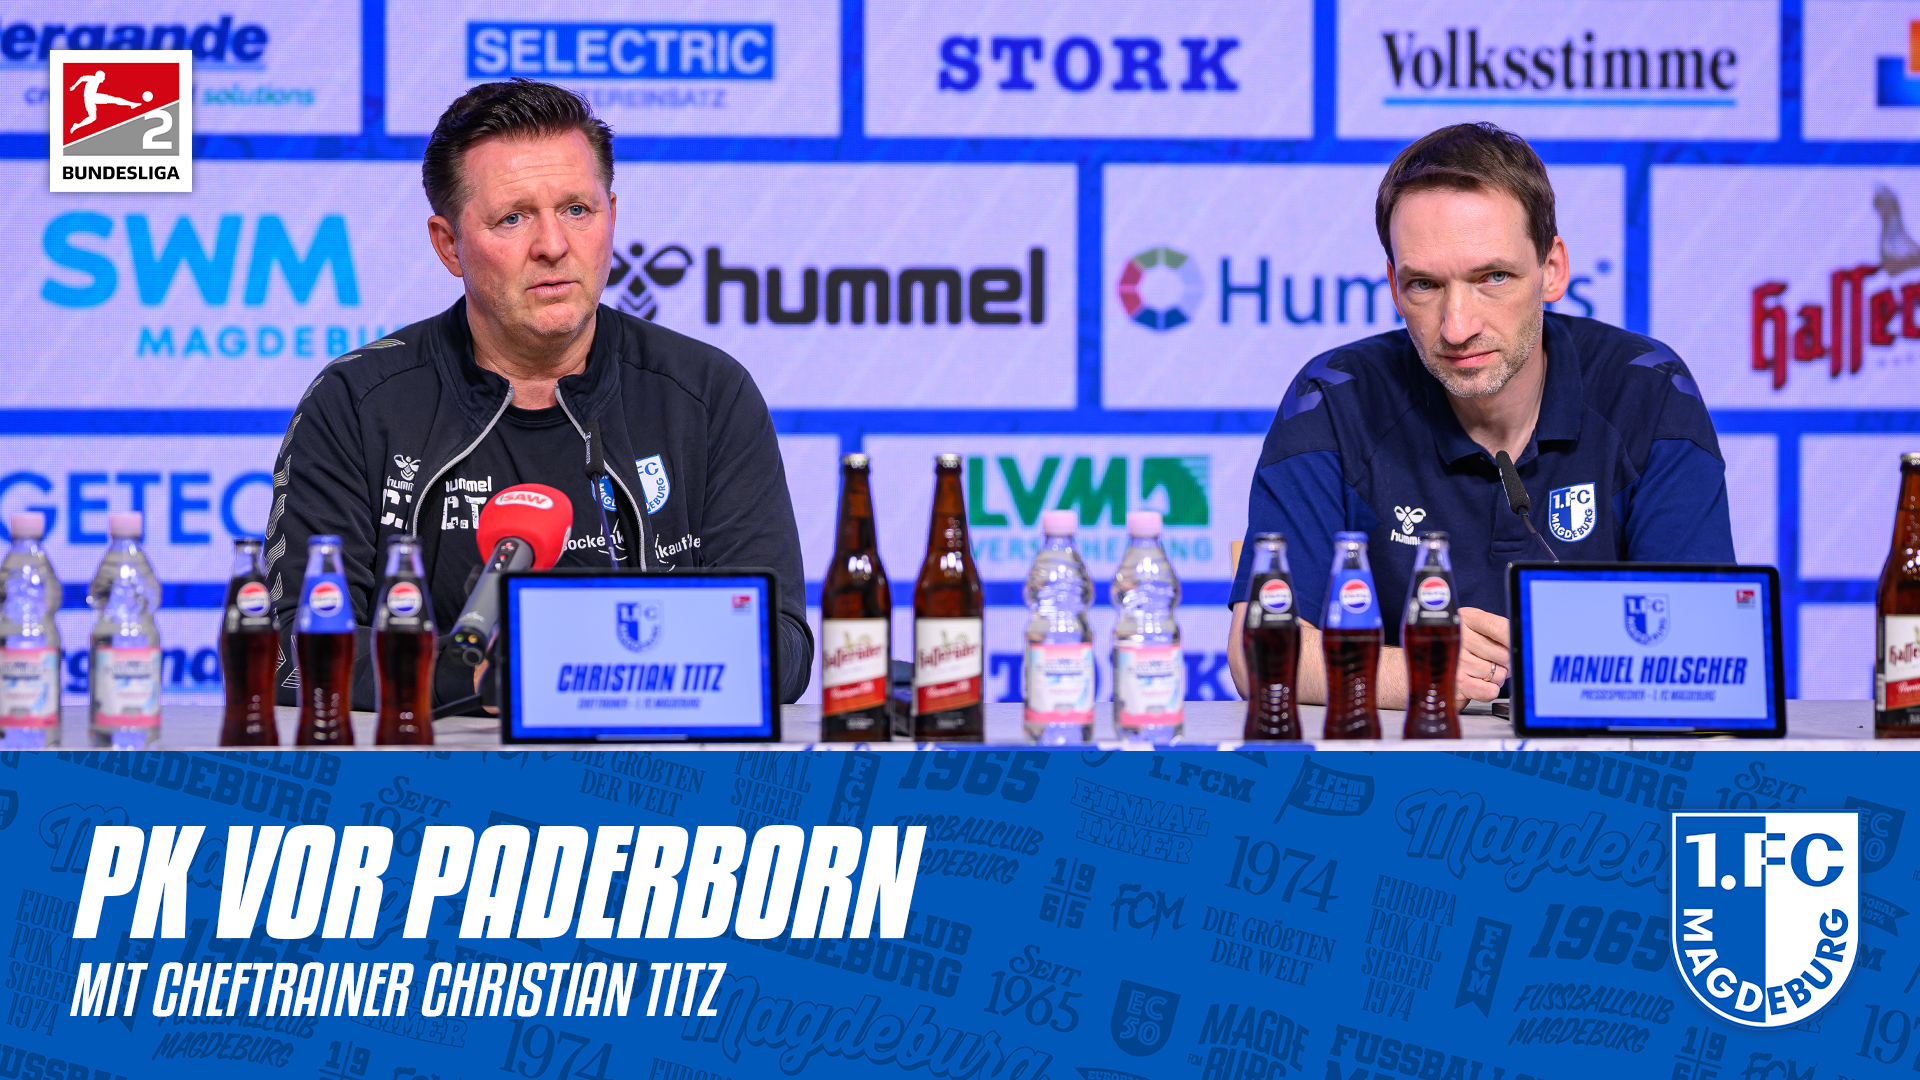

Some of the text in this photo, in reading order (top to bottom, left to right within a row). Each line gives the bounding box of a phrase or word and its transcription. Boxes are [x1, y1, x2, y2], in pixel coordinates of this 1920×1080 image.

[473, 27, 769, 75] SELECTRIC
[937, 36, 1242, 92] STORK
[1381, 28, 1739, 91] Volksstimme
[40, 210, 361, 310] SWM
[705, 246, 1046, 325] hummel
[968, 456, 1128, 526] LVM
[1551, 508, 1594, 539] MAGDEBURG
[557, 664, 726, 692] CHRISTIAN TITZ
[1550, 655, 1634, 684] MANUEL
